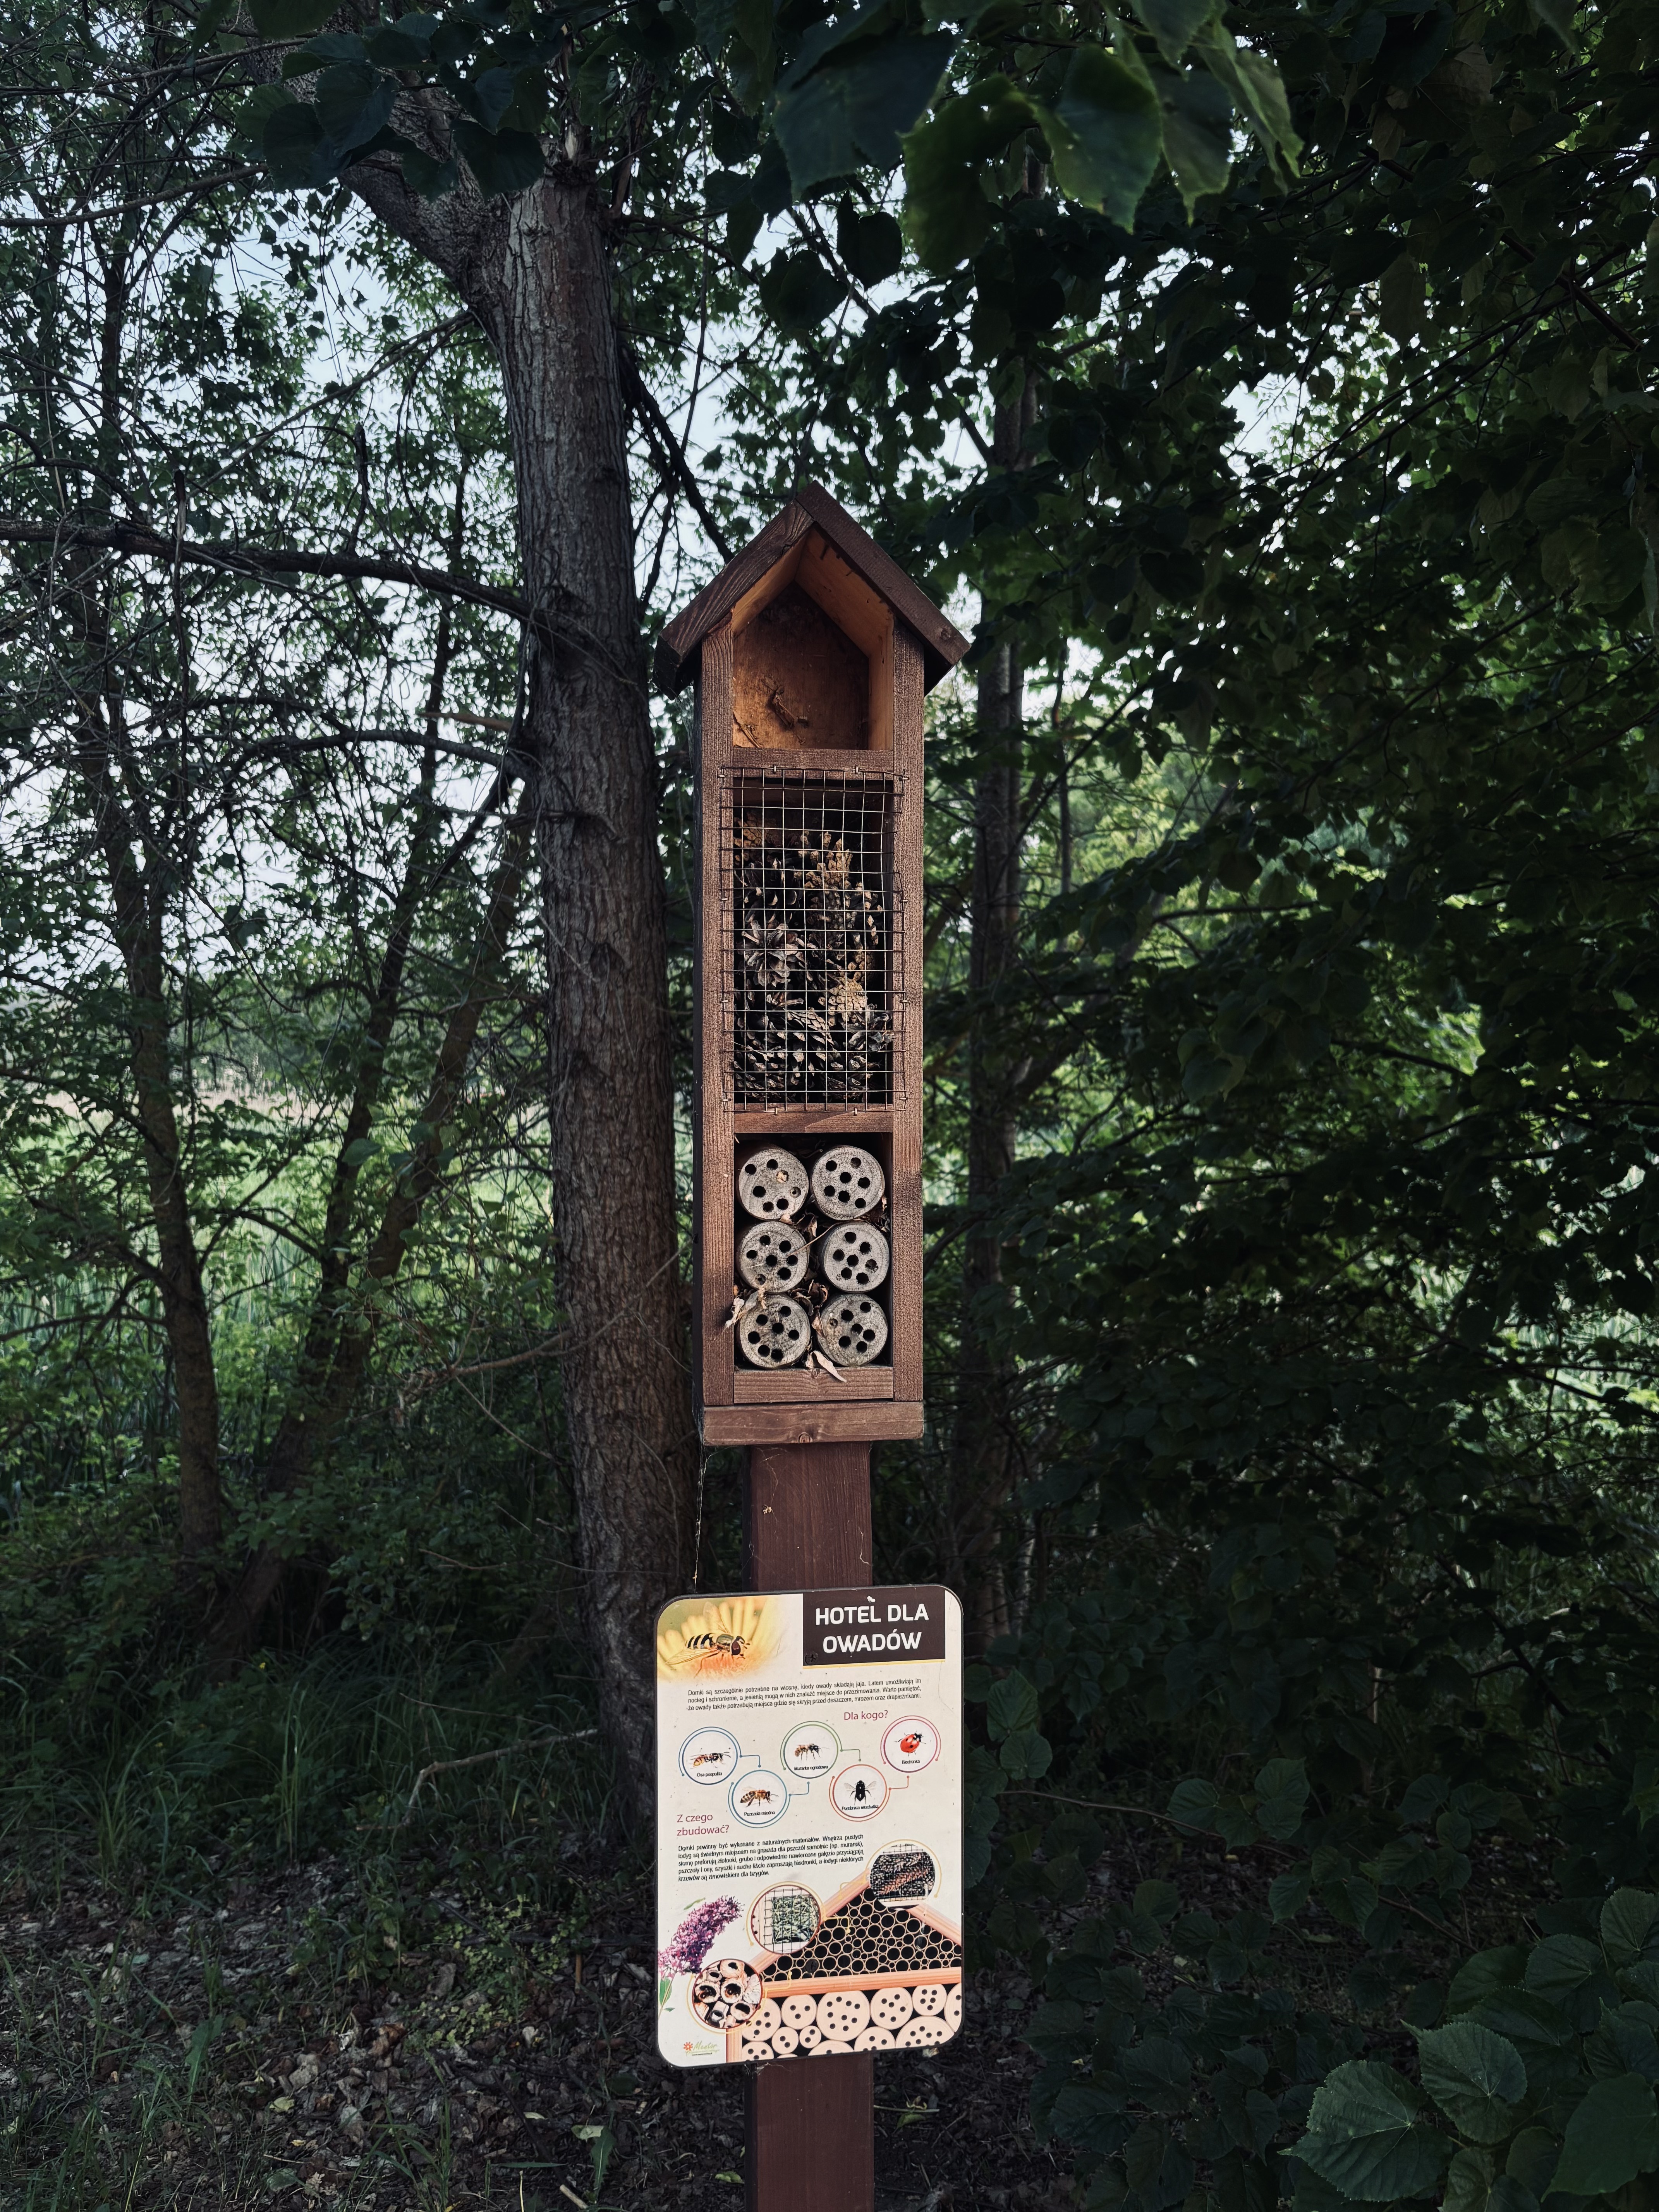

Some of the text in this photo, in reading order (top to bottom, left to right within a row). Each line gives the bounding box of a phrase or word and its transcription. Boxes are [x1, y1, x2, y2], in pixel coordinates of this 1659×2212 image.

[816, 1603, 929, 1625] HOTEL DLA
[823, 1628, 922, 1653] OWADÓW
[898, 1686, 921, 1695] pamiętać,
[844, 1710, 888, 1721] Dla kogo?
[677, 1814, 713, 1824] Z czego
[677, 1824, 729, 1836] zbudować?
[757, 1847, 776, 1856] gniazda
[841, 1842, 863, 1850] murarek),
[818, 1851, 835, 1859] gałęzie
[836, 1849, 864, 1858] przyciągają
